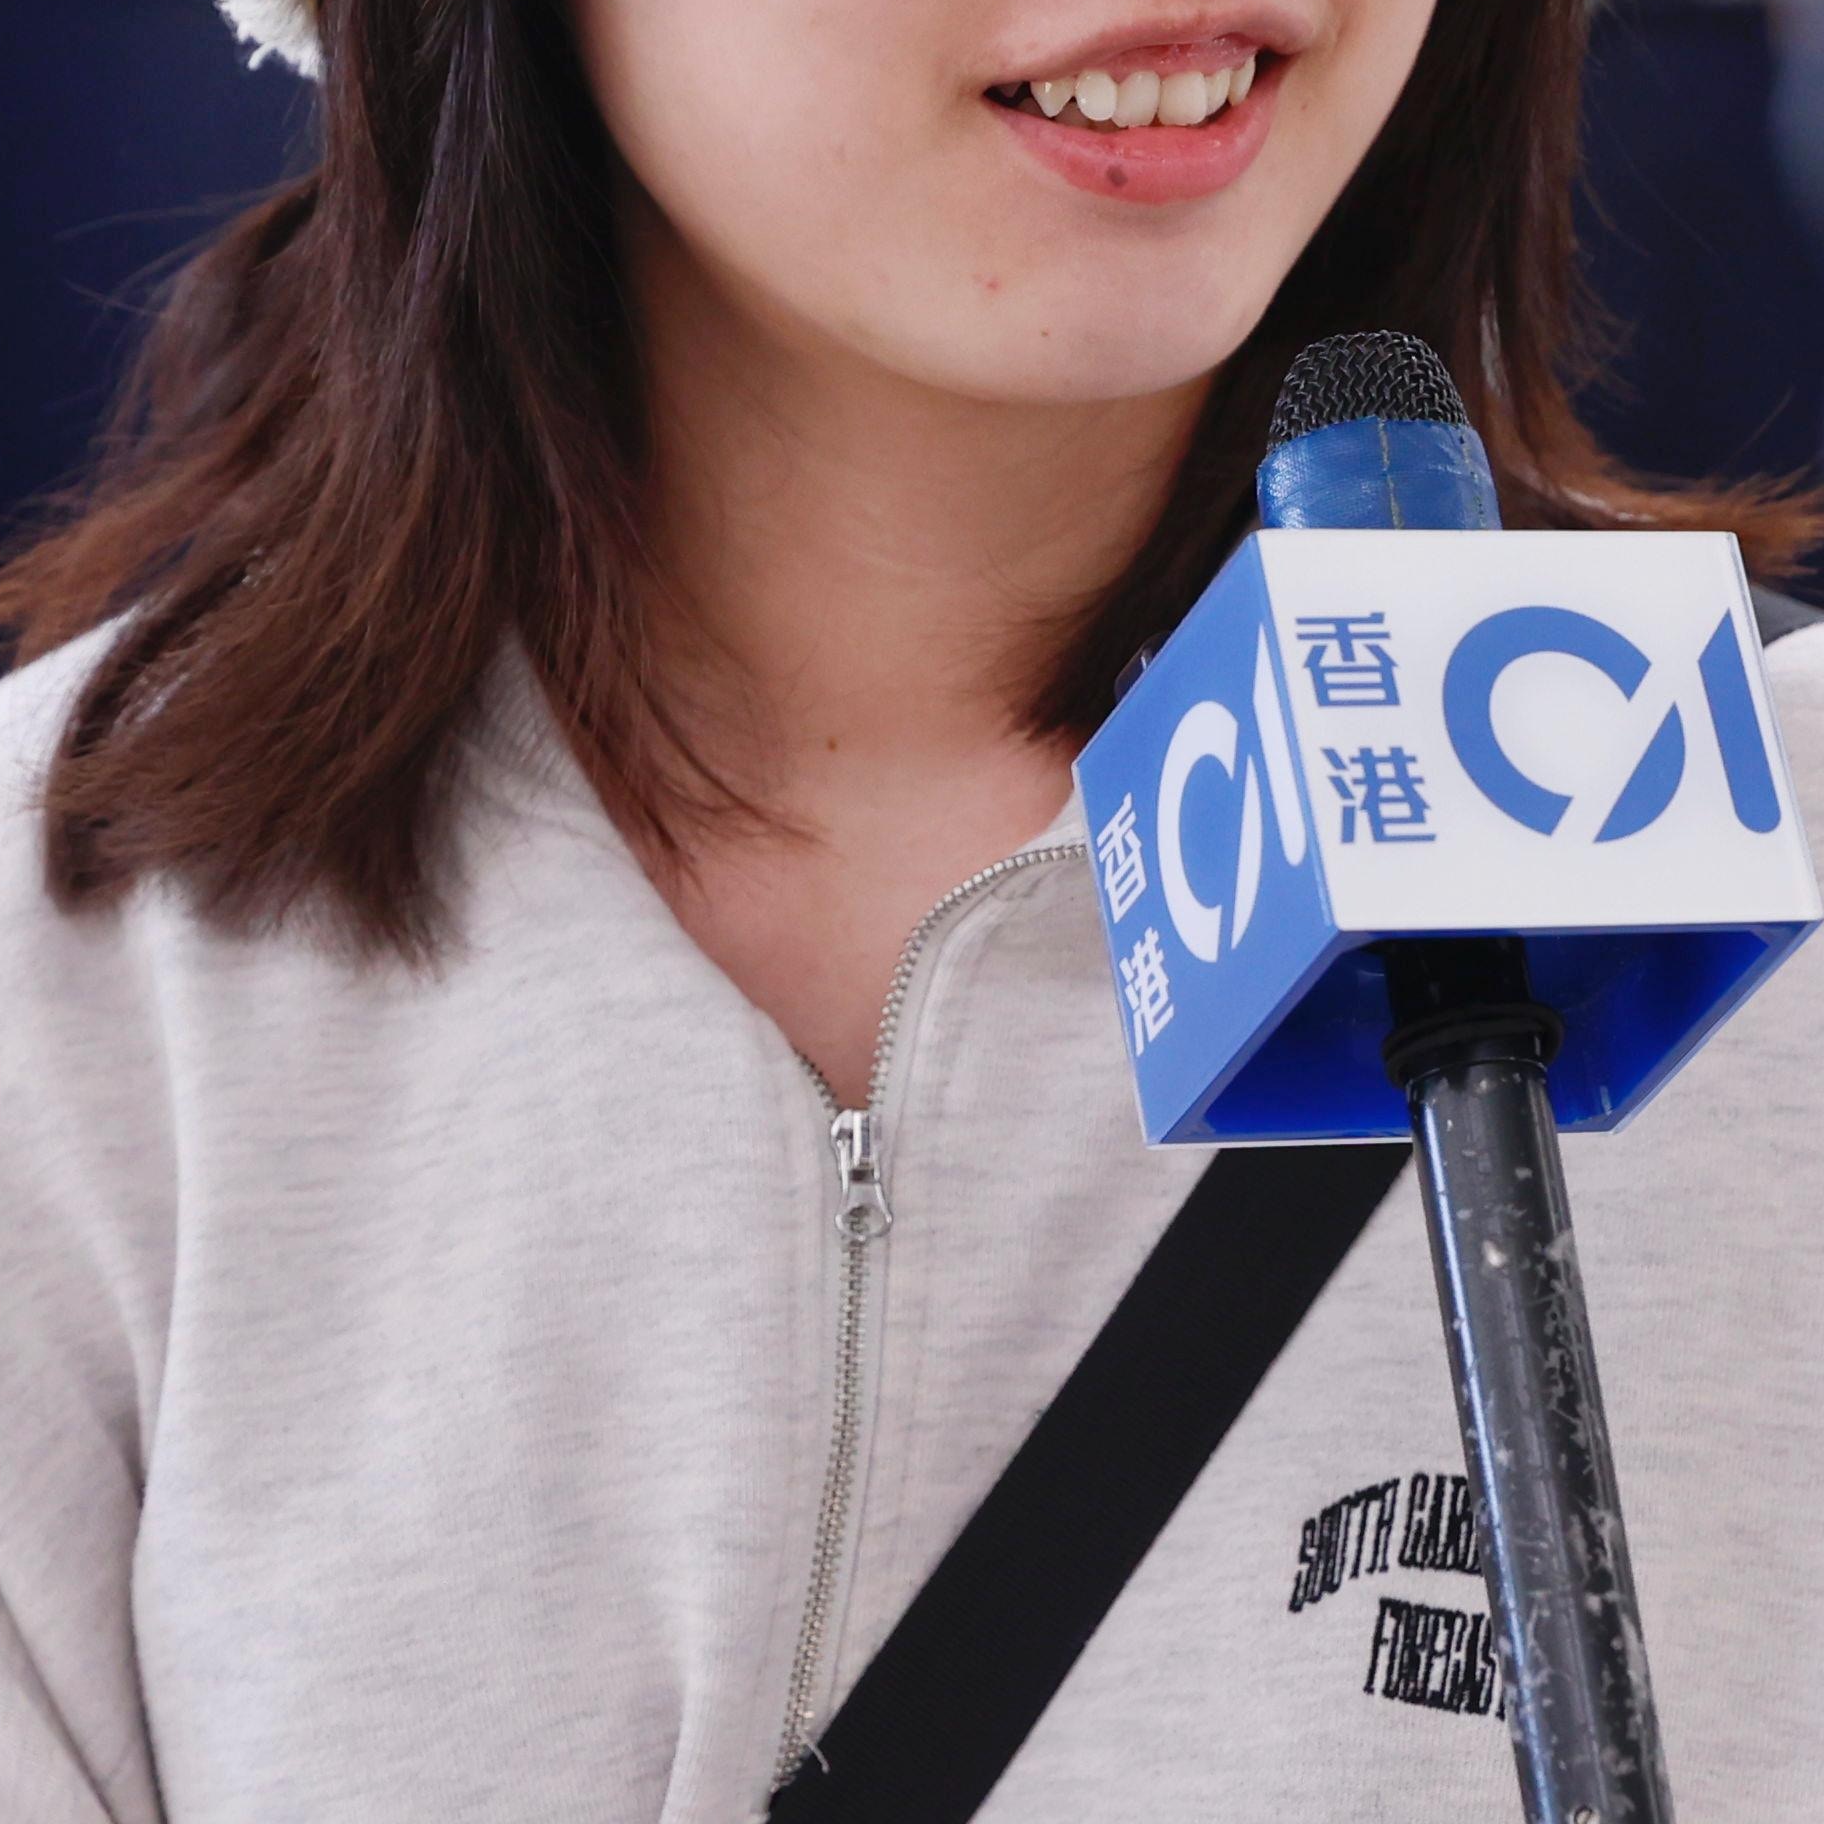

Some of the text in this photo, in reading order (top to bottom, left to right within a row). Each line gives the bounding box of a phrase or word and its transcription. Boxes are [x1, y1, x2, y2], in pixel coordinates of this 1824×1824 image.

[1295, 610, 1437, 844] 香港
[1096, 790, 1175, 1057] 香港
[1287, 1472, 1487, 1613] SOUTH CAR
[1362, 1596, 1507, 1723] FORECAS
